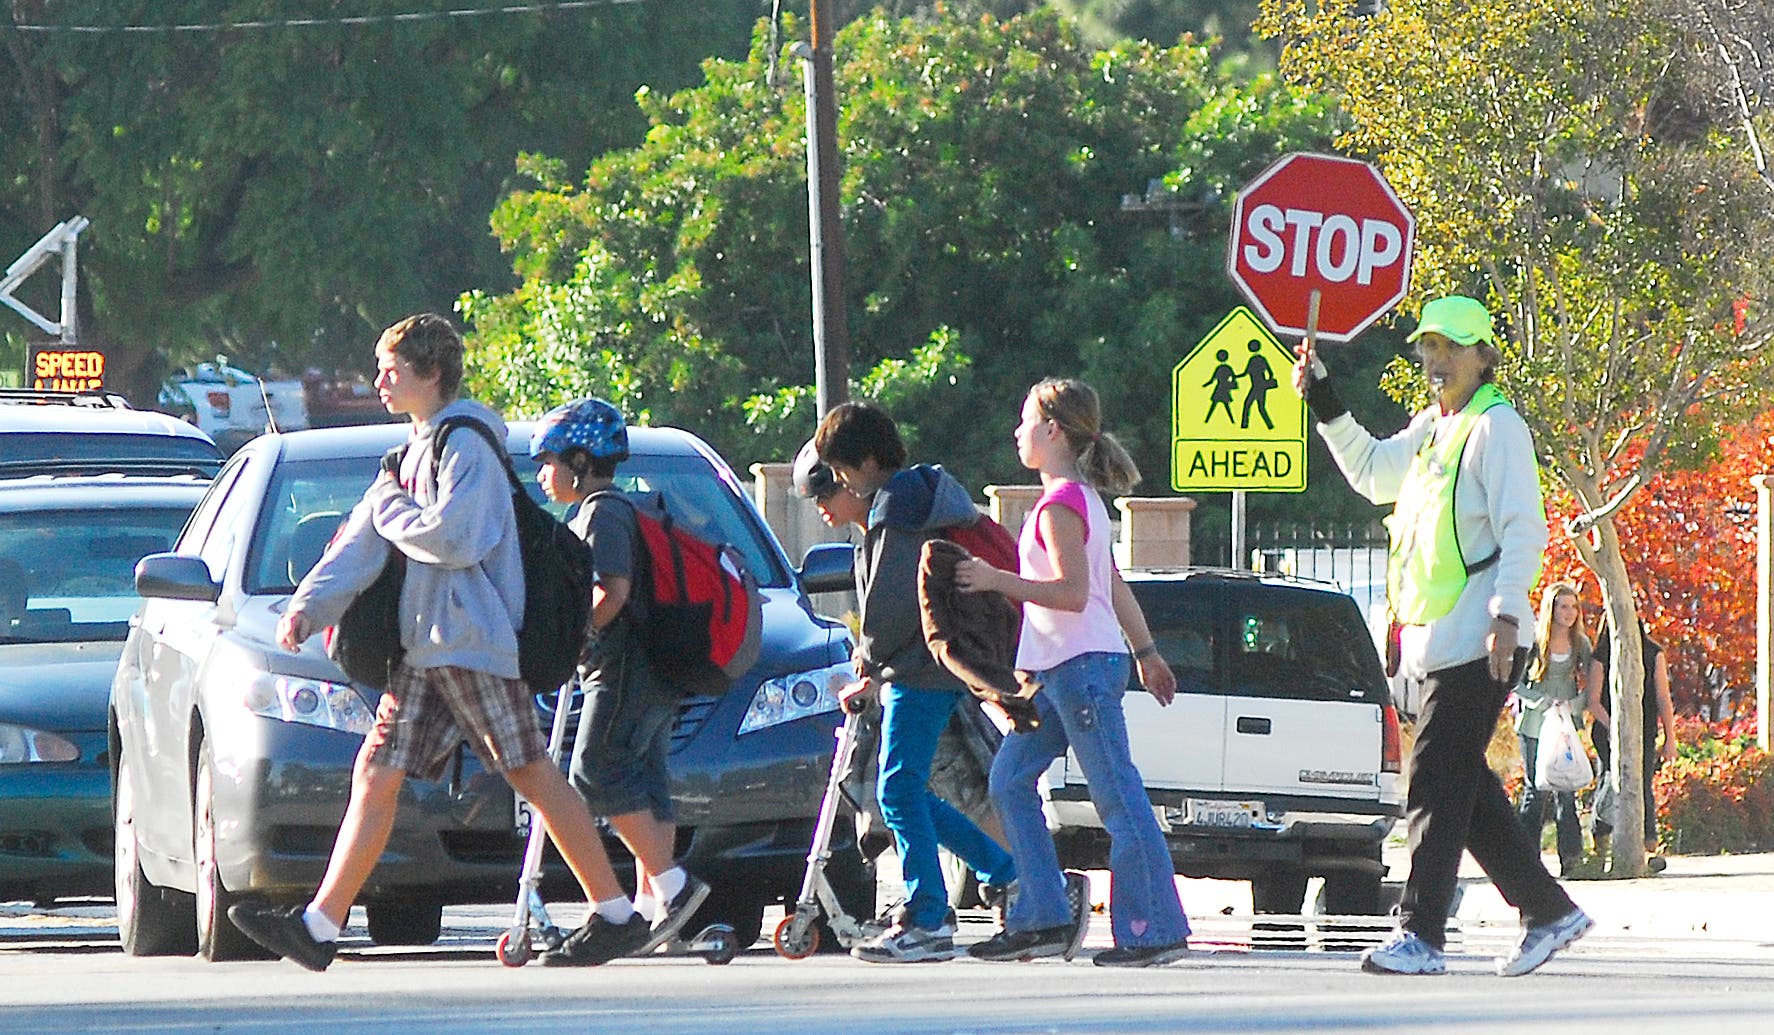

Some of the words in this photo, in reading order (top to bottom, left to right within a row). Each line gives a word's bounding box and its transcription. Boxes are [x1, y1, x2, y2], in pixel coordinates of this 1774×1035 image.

[1244, 204, 1402, 285] STOP
[35, 351, 105, 378] SPEED
[1188, 451, 1292, 478] AHEAD
